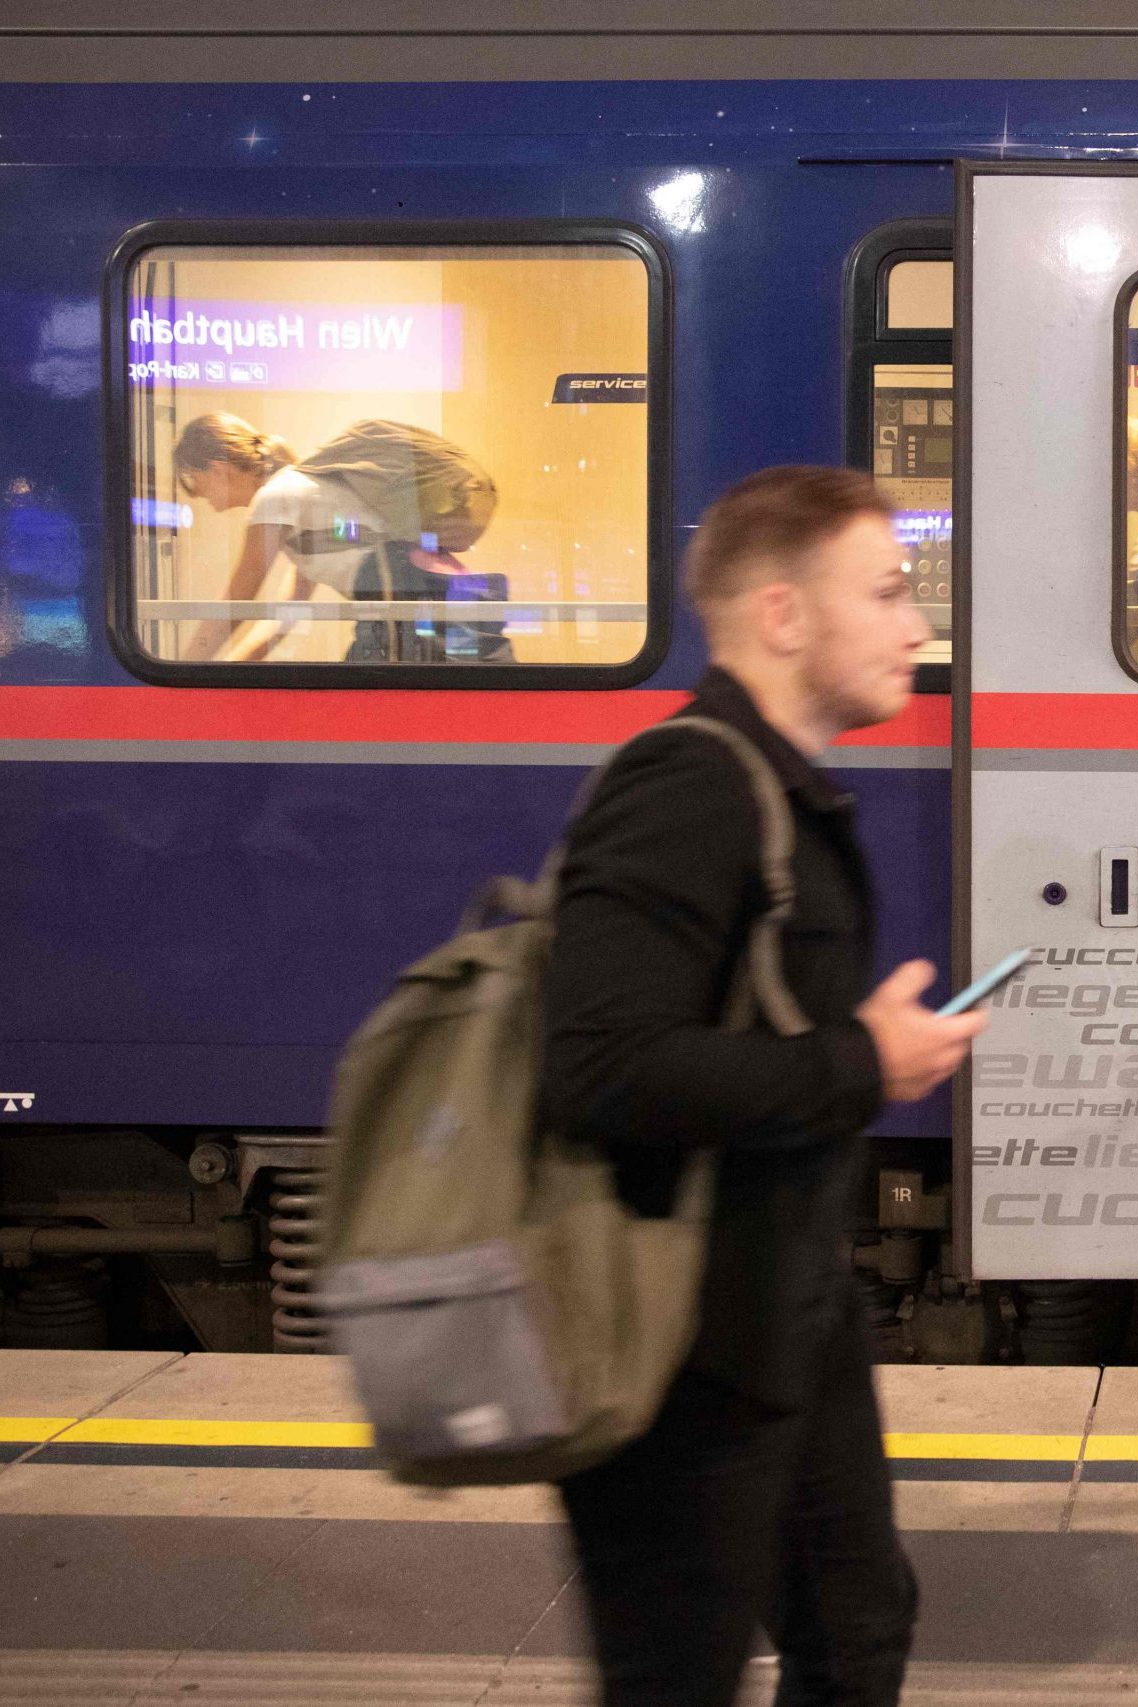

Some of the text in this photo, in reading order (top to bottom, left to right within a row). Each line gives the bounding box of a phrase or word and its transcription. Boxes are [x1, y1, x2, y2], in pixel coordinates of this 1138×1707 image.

[569, 378, 648, 389] service
[972, 1138, 1078, 1166] ette
[891, 1187, 912, 1202] 1R
